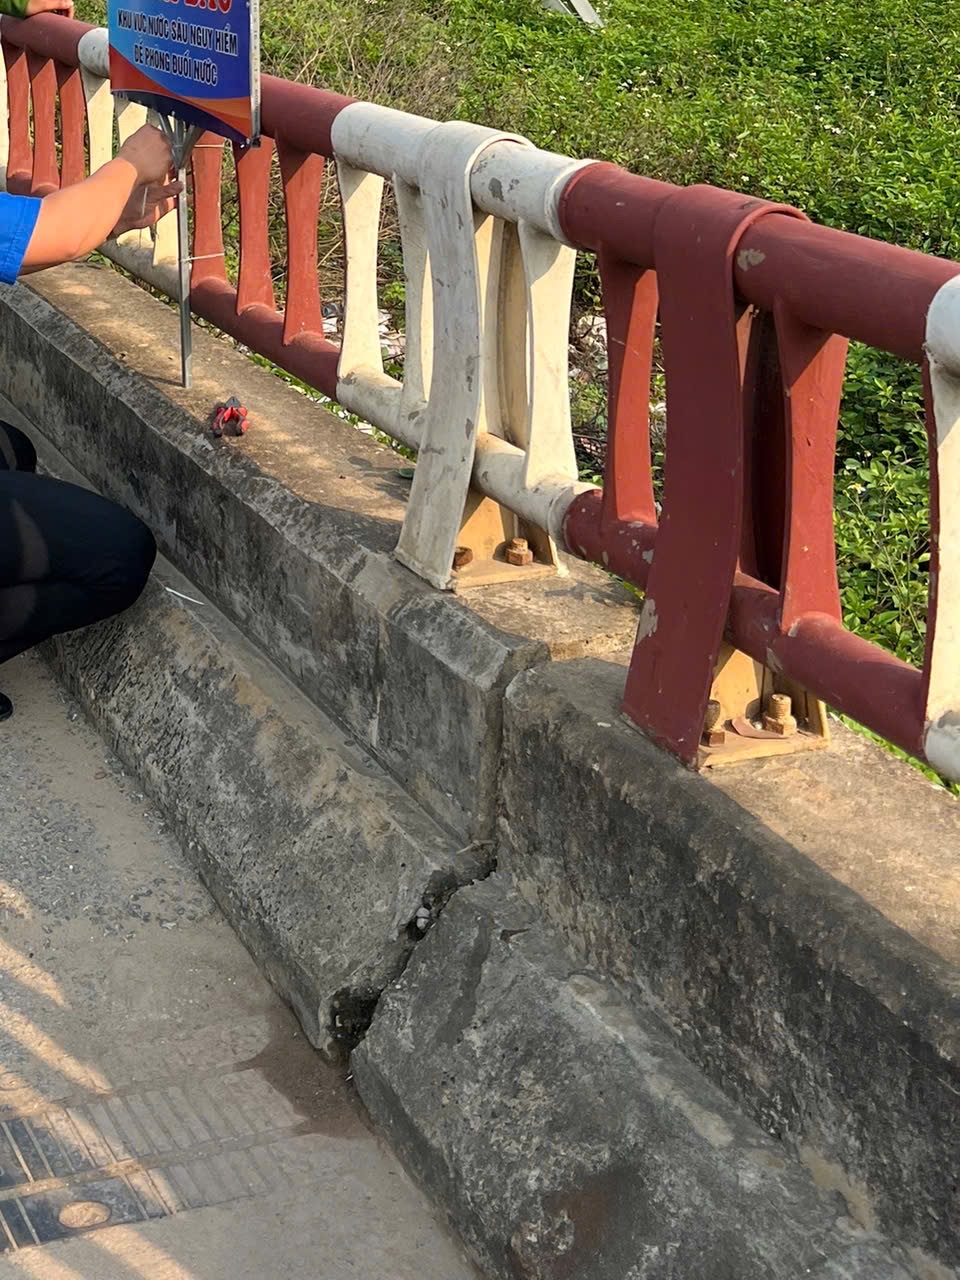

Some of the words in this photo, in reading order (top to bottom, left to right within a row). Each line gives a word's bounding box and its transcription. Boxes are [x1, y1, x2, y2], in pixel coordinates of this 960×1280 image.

[117, 8, 133, 30] KHU
[148, 14, 171, 40] NƯỚC
[171, 16, 188, 45] SÂU
[190, 24, 214, 51] NGUY
[215, 22, 238, 56] HIỂM
[144, 43, 171, 73] PHÒNG
[172, 49, 192, 79] ĐUỐI
[193, 57, 218, 87] NƯỚC
